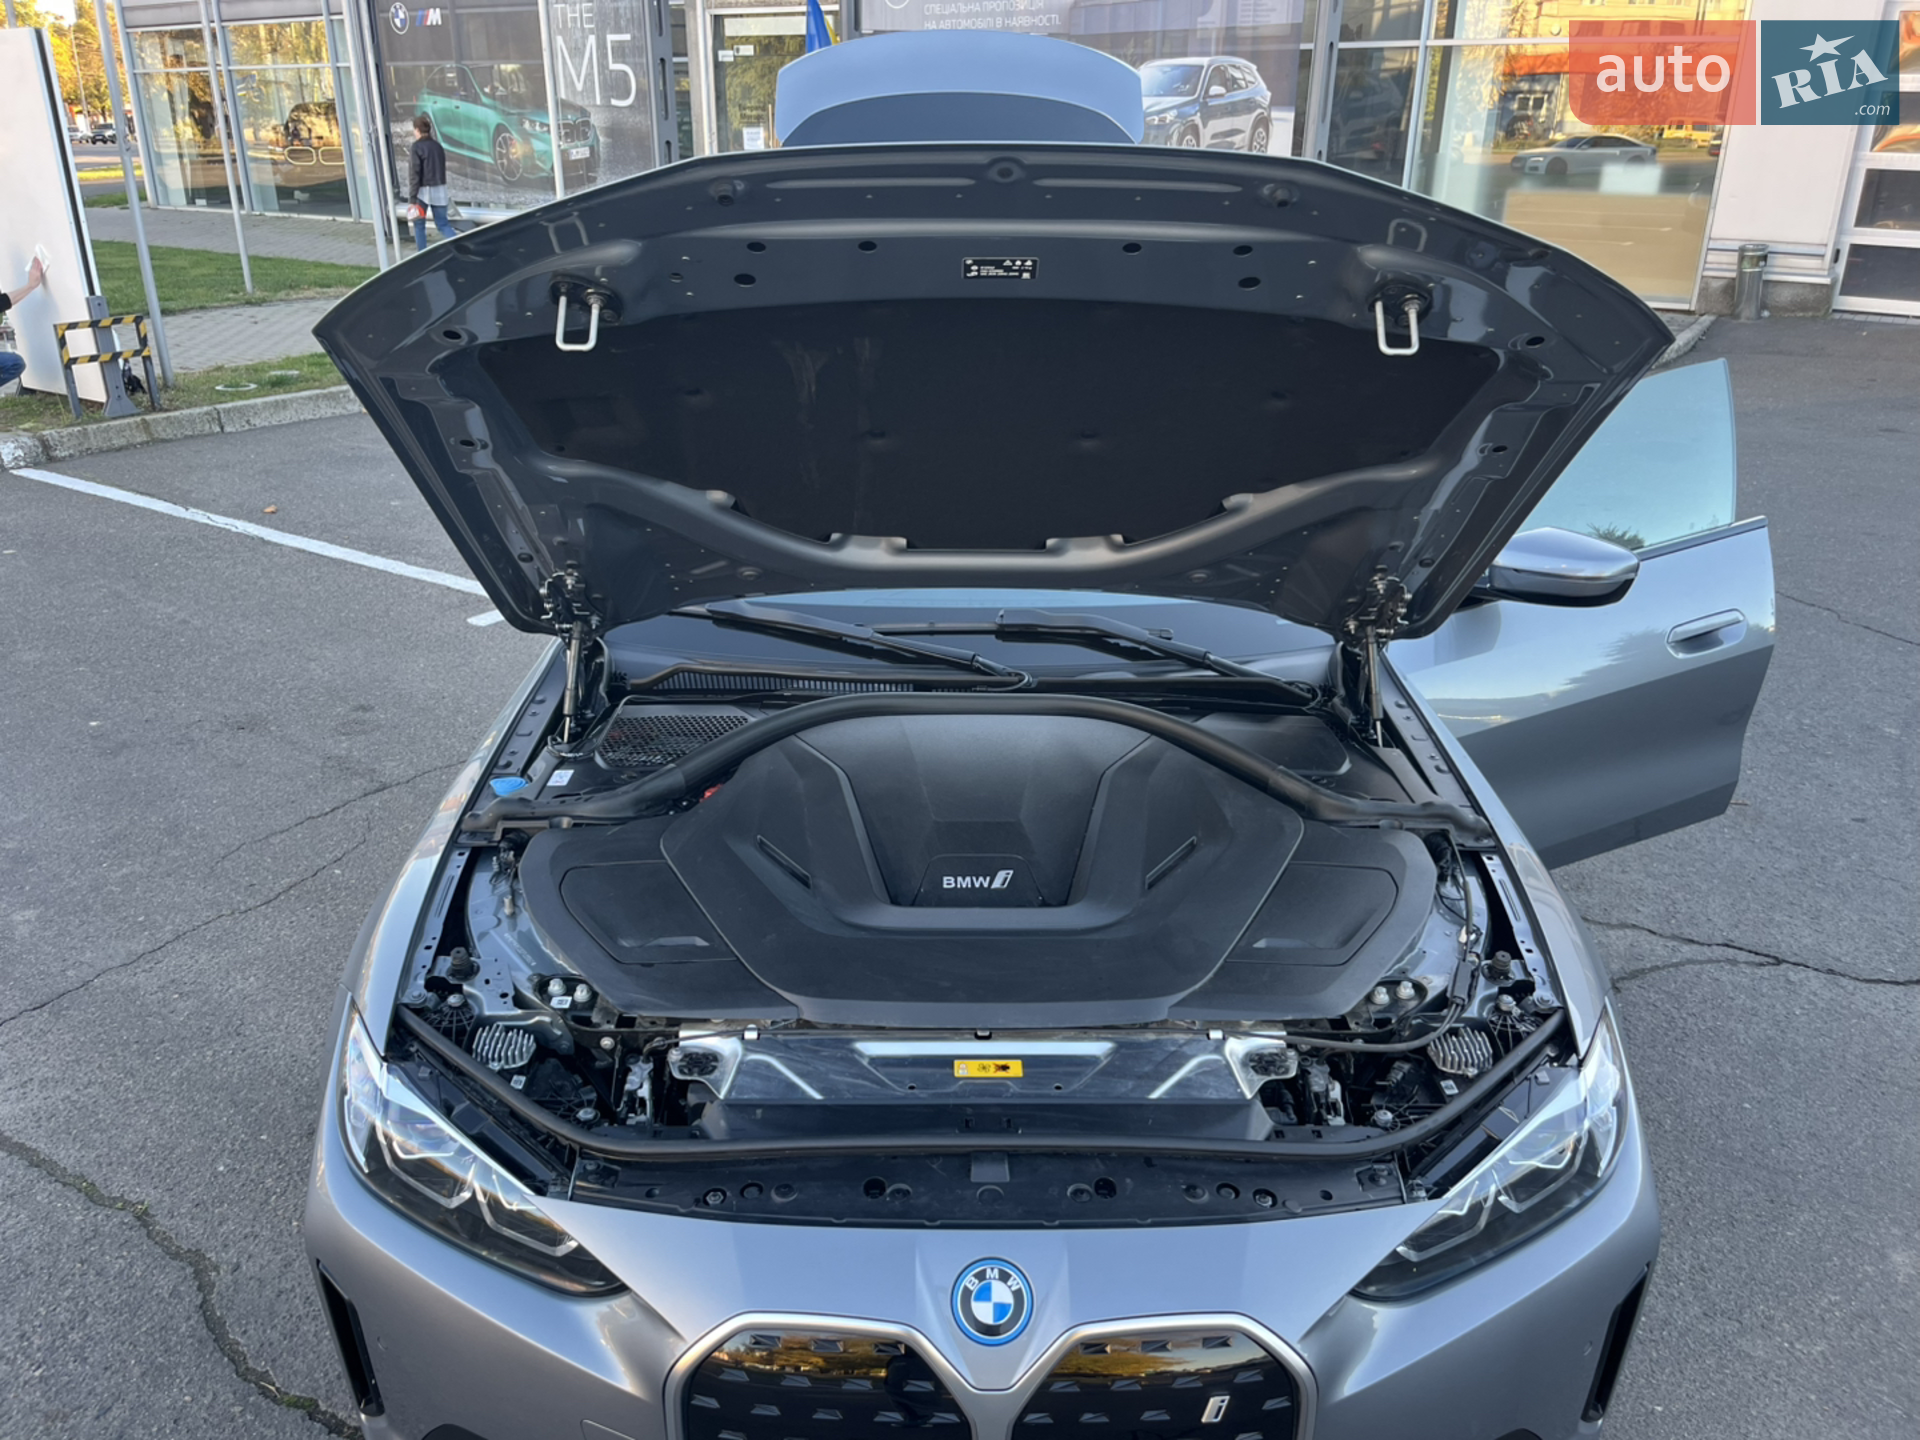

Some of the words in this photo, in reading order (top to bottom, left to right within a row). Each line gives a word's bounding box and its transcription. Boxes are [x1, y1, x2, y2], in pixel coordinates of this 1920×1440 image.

[554, 2, 596, 28] THE
[923, 2, 981, 15] СПЕЦІАЛЬНА
[924, 20, 937, 30] НА
[939, 18, 994, 30] АВТОМОБІЛІ
[995, 17, 1003, 28] В
[556, 33, 637, 107] M5
[942, 876, 990, 889] BMW
[964, 1267, 1021, 1292] BMW
